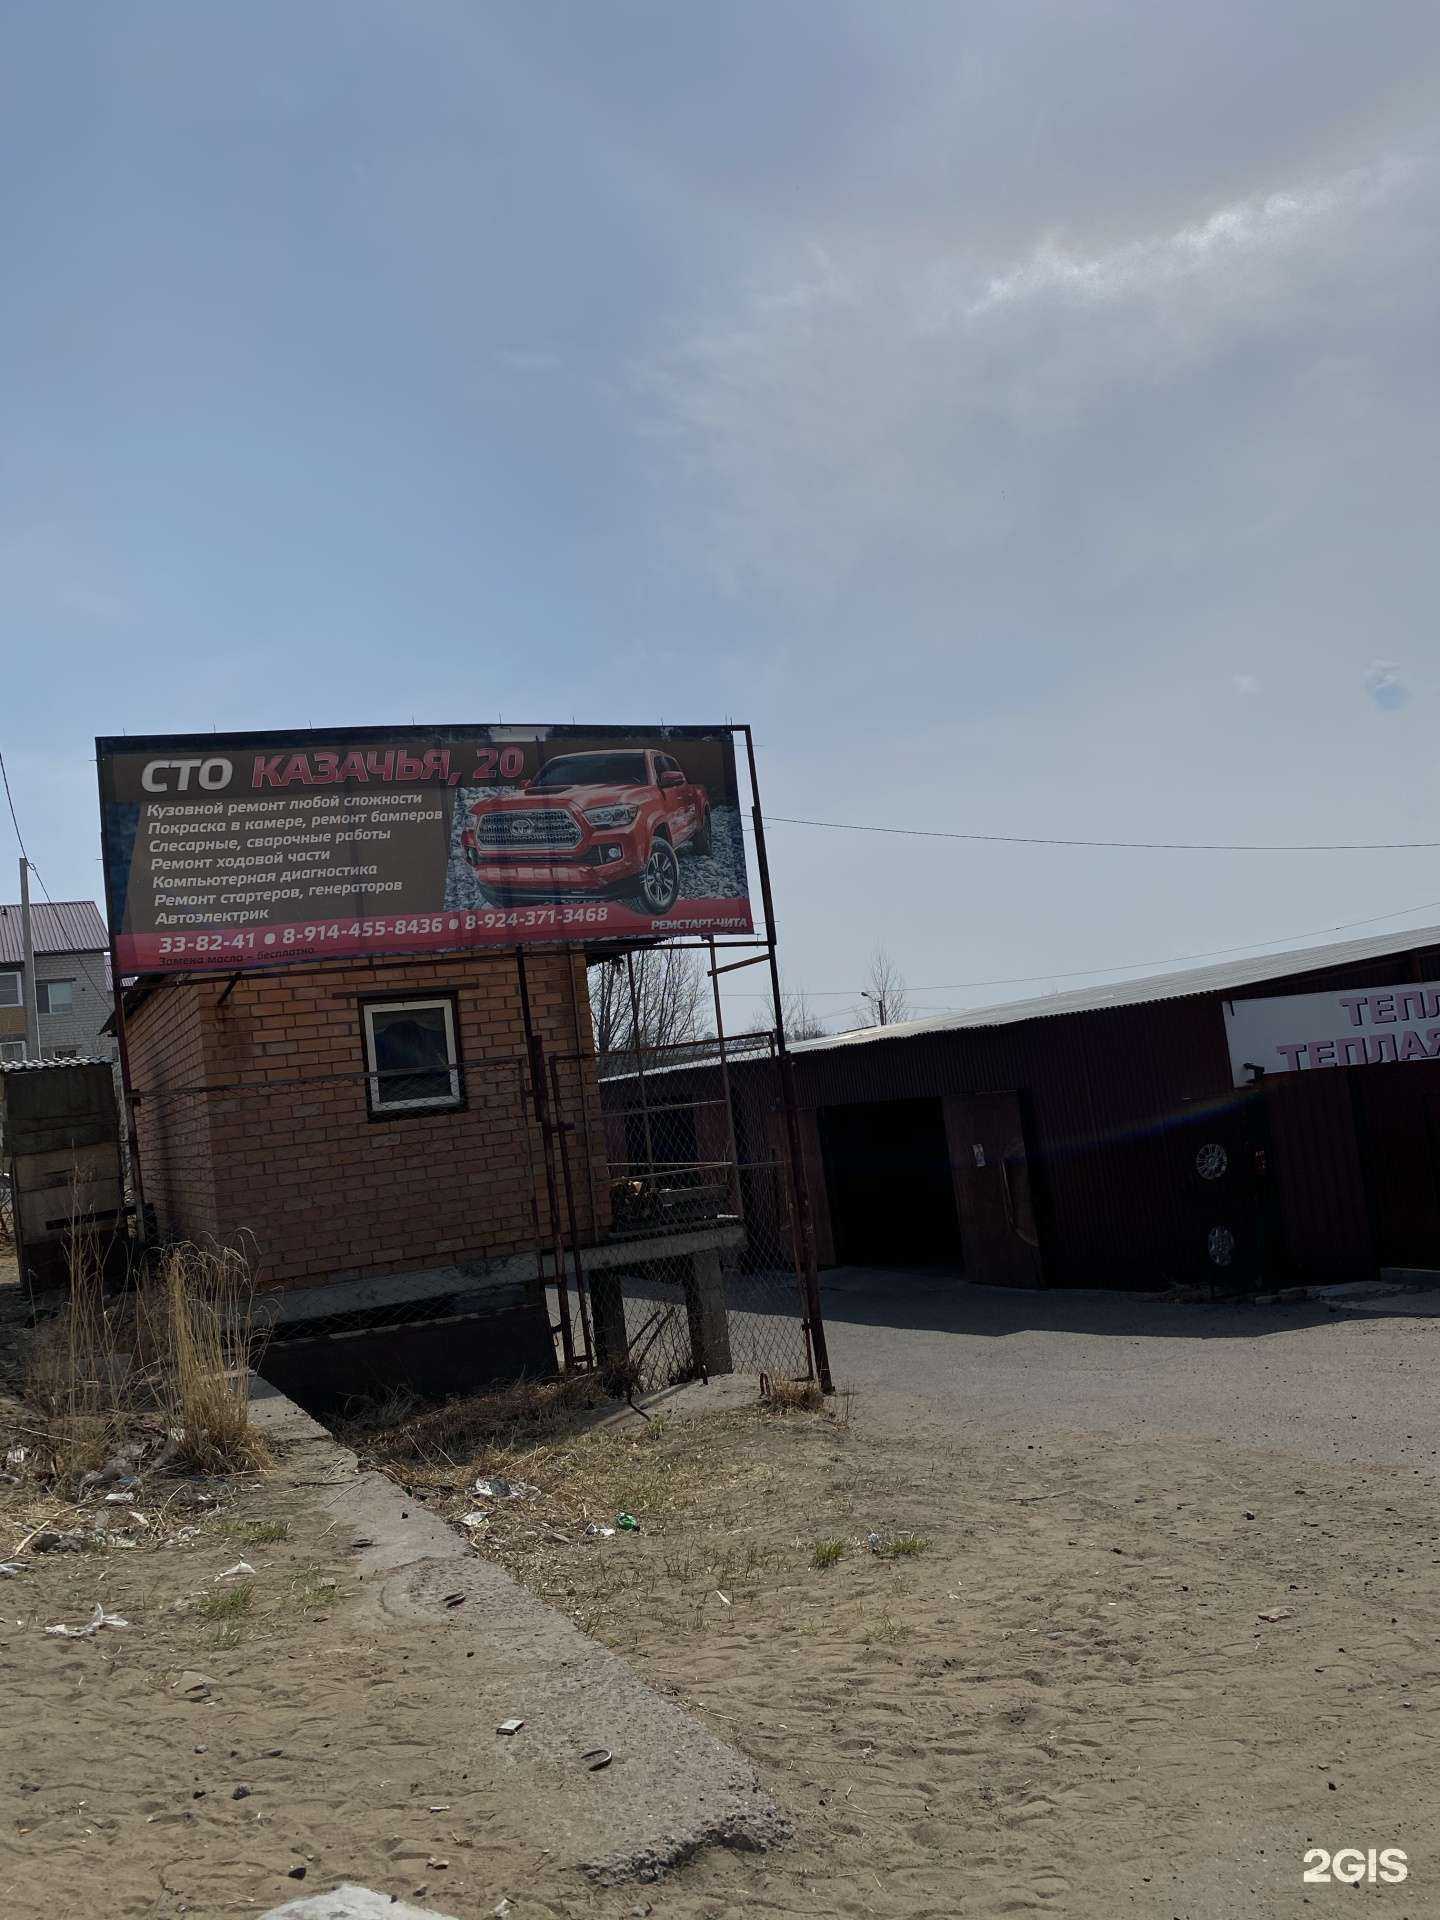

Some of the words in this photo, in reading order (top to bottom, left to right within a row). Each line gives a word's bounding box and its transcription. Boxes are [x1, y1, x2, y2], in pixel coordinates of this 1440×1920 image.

[141, 758, 233, 793] СТО
[252, 749, 462, 788] КАЗАЧЬЯ,
[472, 746, 524, 779] 20
[146, 803, 224, 818] Кузовной
[228, 799, 286, 816] ремонт
[289, 795, 340, 810] любой
[343, 793, 423, 807] сложности
[148, 820, 226, 835] Покраска
[230, 822, 241, 832] в
[245, 816, 306, 832] камере,
[312, 813, 368, 828] ремонт
[371, 809, 443, 826] бамперов
[149, 838, 241, 854] Слесарные,
[246, 832, 332, 851] сварочные
[336, 829, 391, 844] работы
[151, 857, 212, 872] Ремонт
[216, 851, 284, 869] ходовой
[287, 849, 330, 863] части
[152, 872, 276, 890] Компьютерная
[280, 864, 378, 882] диагностика
[154, 893, 217, 907] Ремонт
[220, 887, 304, 905] стартеров,
[309, 880, 403, 898] генераторов
[155, 908, 270, 925] Автоэлектрик
[651, 918, 748, 930] РЕМСТАРТ-ЧИТА
[159, 933, 255, 953] 33-82-41
[283, 918, 443, 945] 8-914-455-8436
[465, 907, 608, 929] 8-924-371-3468
